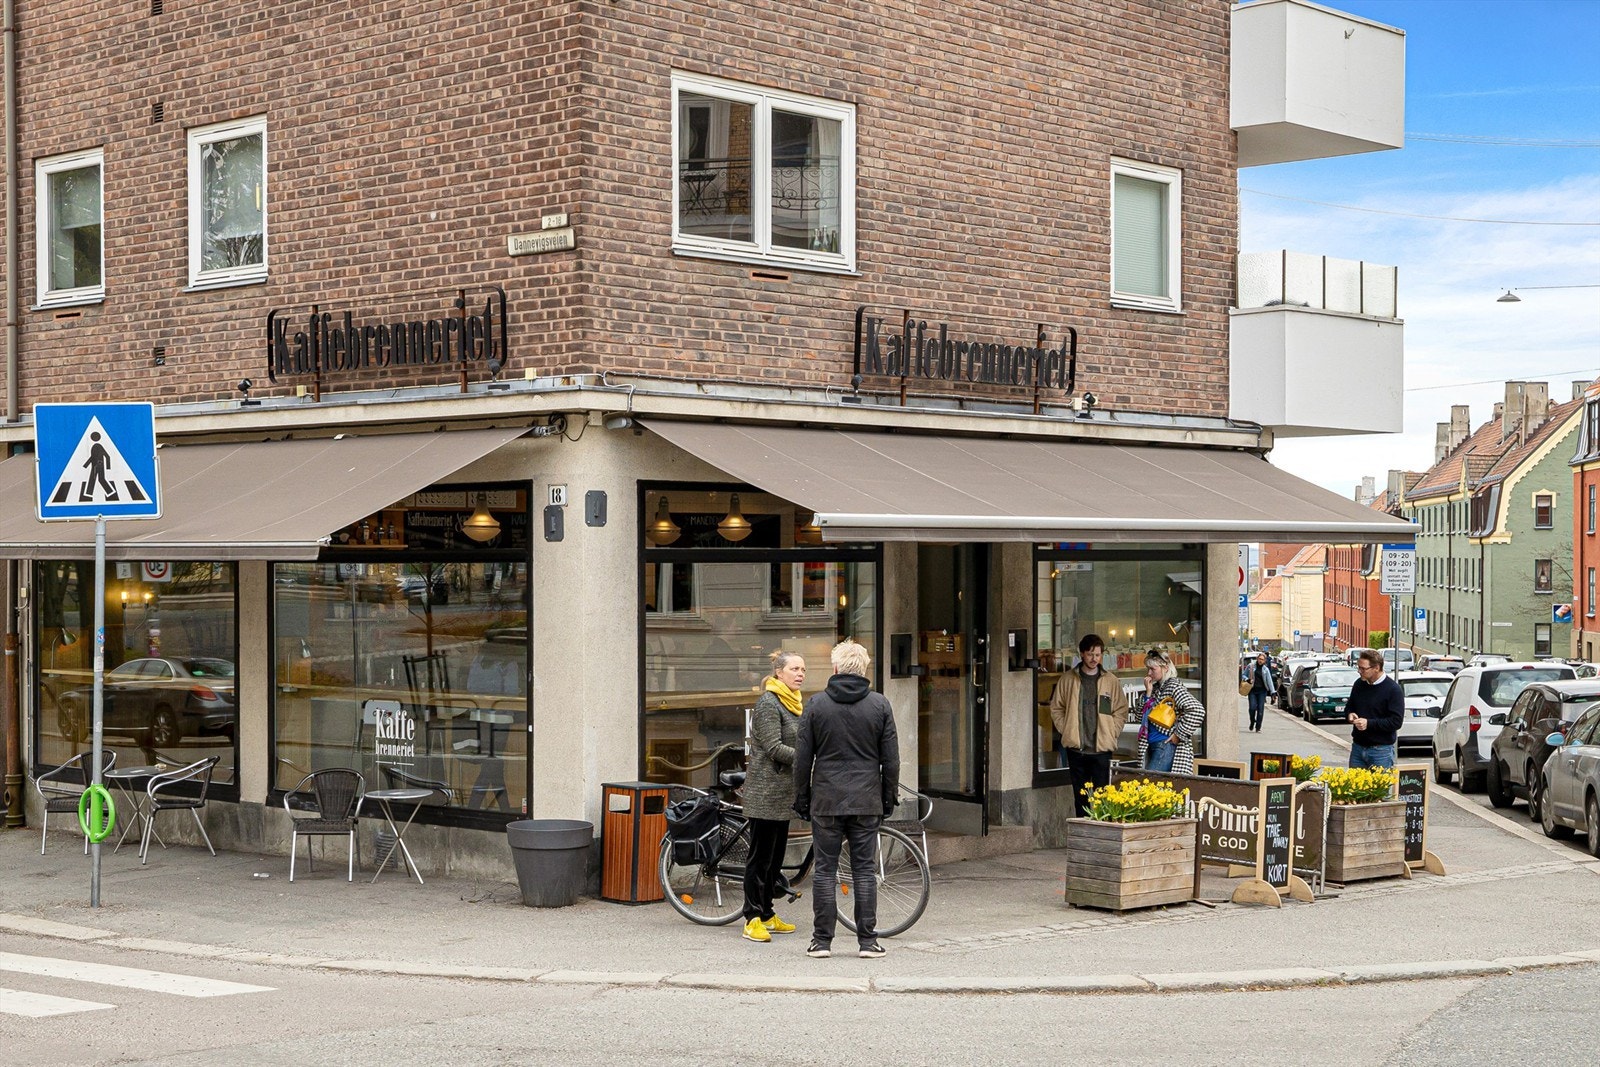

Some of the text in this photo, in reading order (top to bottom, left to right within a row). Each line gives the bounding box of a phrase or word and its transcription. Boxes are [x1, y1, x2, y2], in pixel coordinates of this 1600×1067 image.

[513, 232, 568, 251] Dannevigsveien
[274, 296, 498, 376] Kaffebrenneriet
[864, 316, 1070, 391] Kaffebrenneriet
[550, 487, 562, 504] 18
[1416, 609, 1424, 618] P
[375, 709, 415, 740] Kaffe
[375, 740, 415, 757] brenneriet
[1218, 836, 1248, 850] GOD
[1267, 863, 1288, 883] KORT
